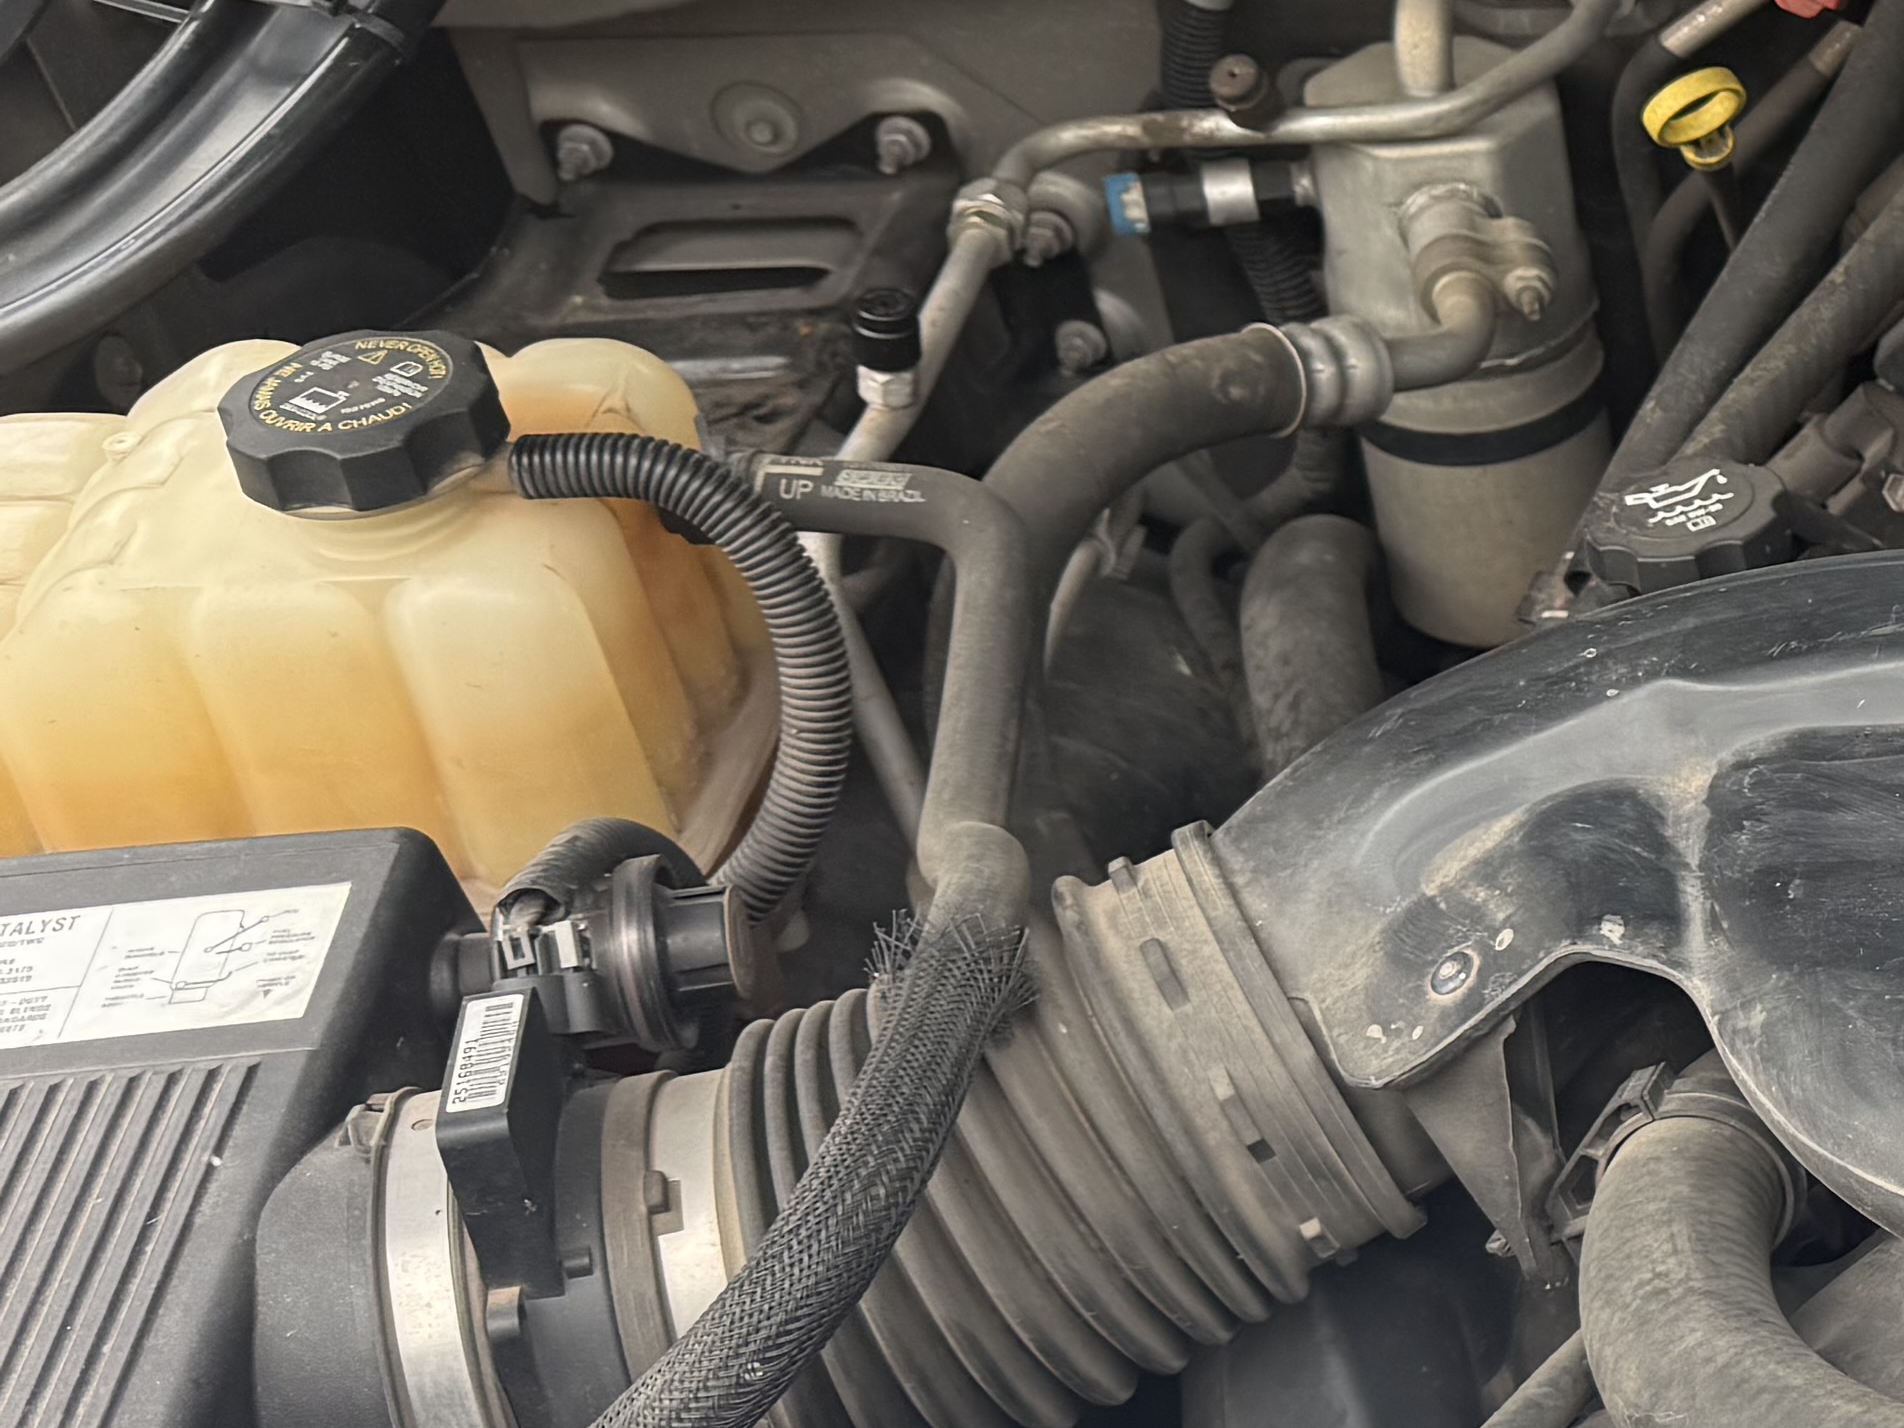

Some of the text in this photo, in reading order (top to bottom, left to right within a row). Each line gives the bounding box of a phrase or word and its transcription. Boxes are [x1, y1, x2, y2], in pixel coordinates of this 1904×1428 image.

[354, 339, 409, 352] NEVER
[259, 409, 318, 433] OUVRIR
[338, 402, 412, 430] CHAUD!
[779, 478, 814, 500] UP
[821, 486, 862, 501] MADE
[452, 1038, 479, 1105] 25168491
